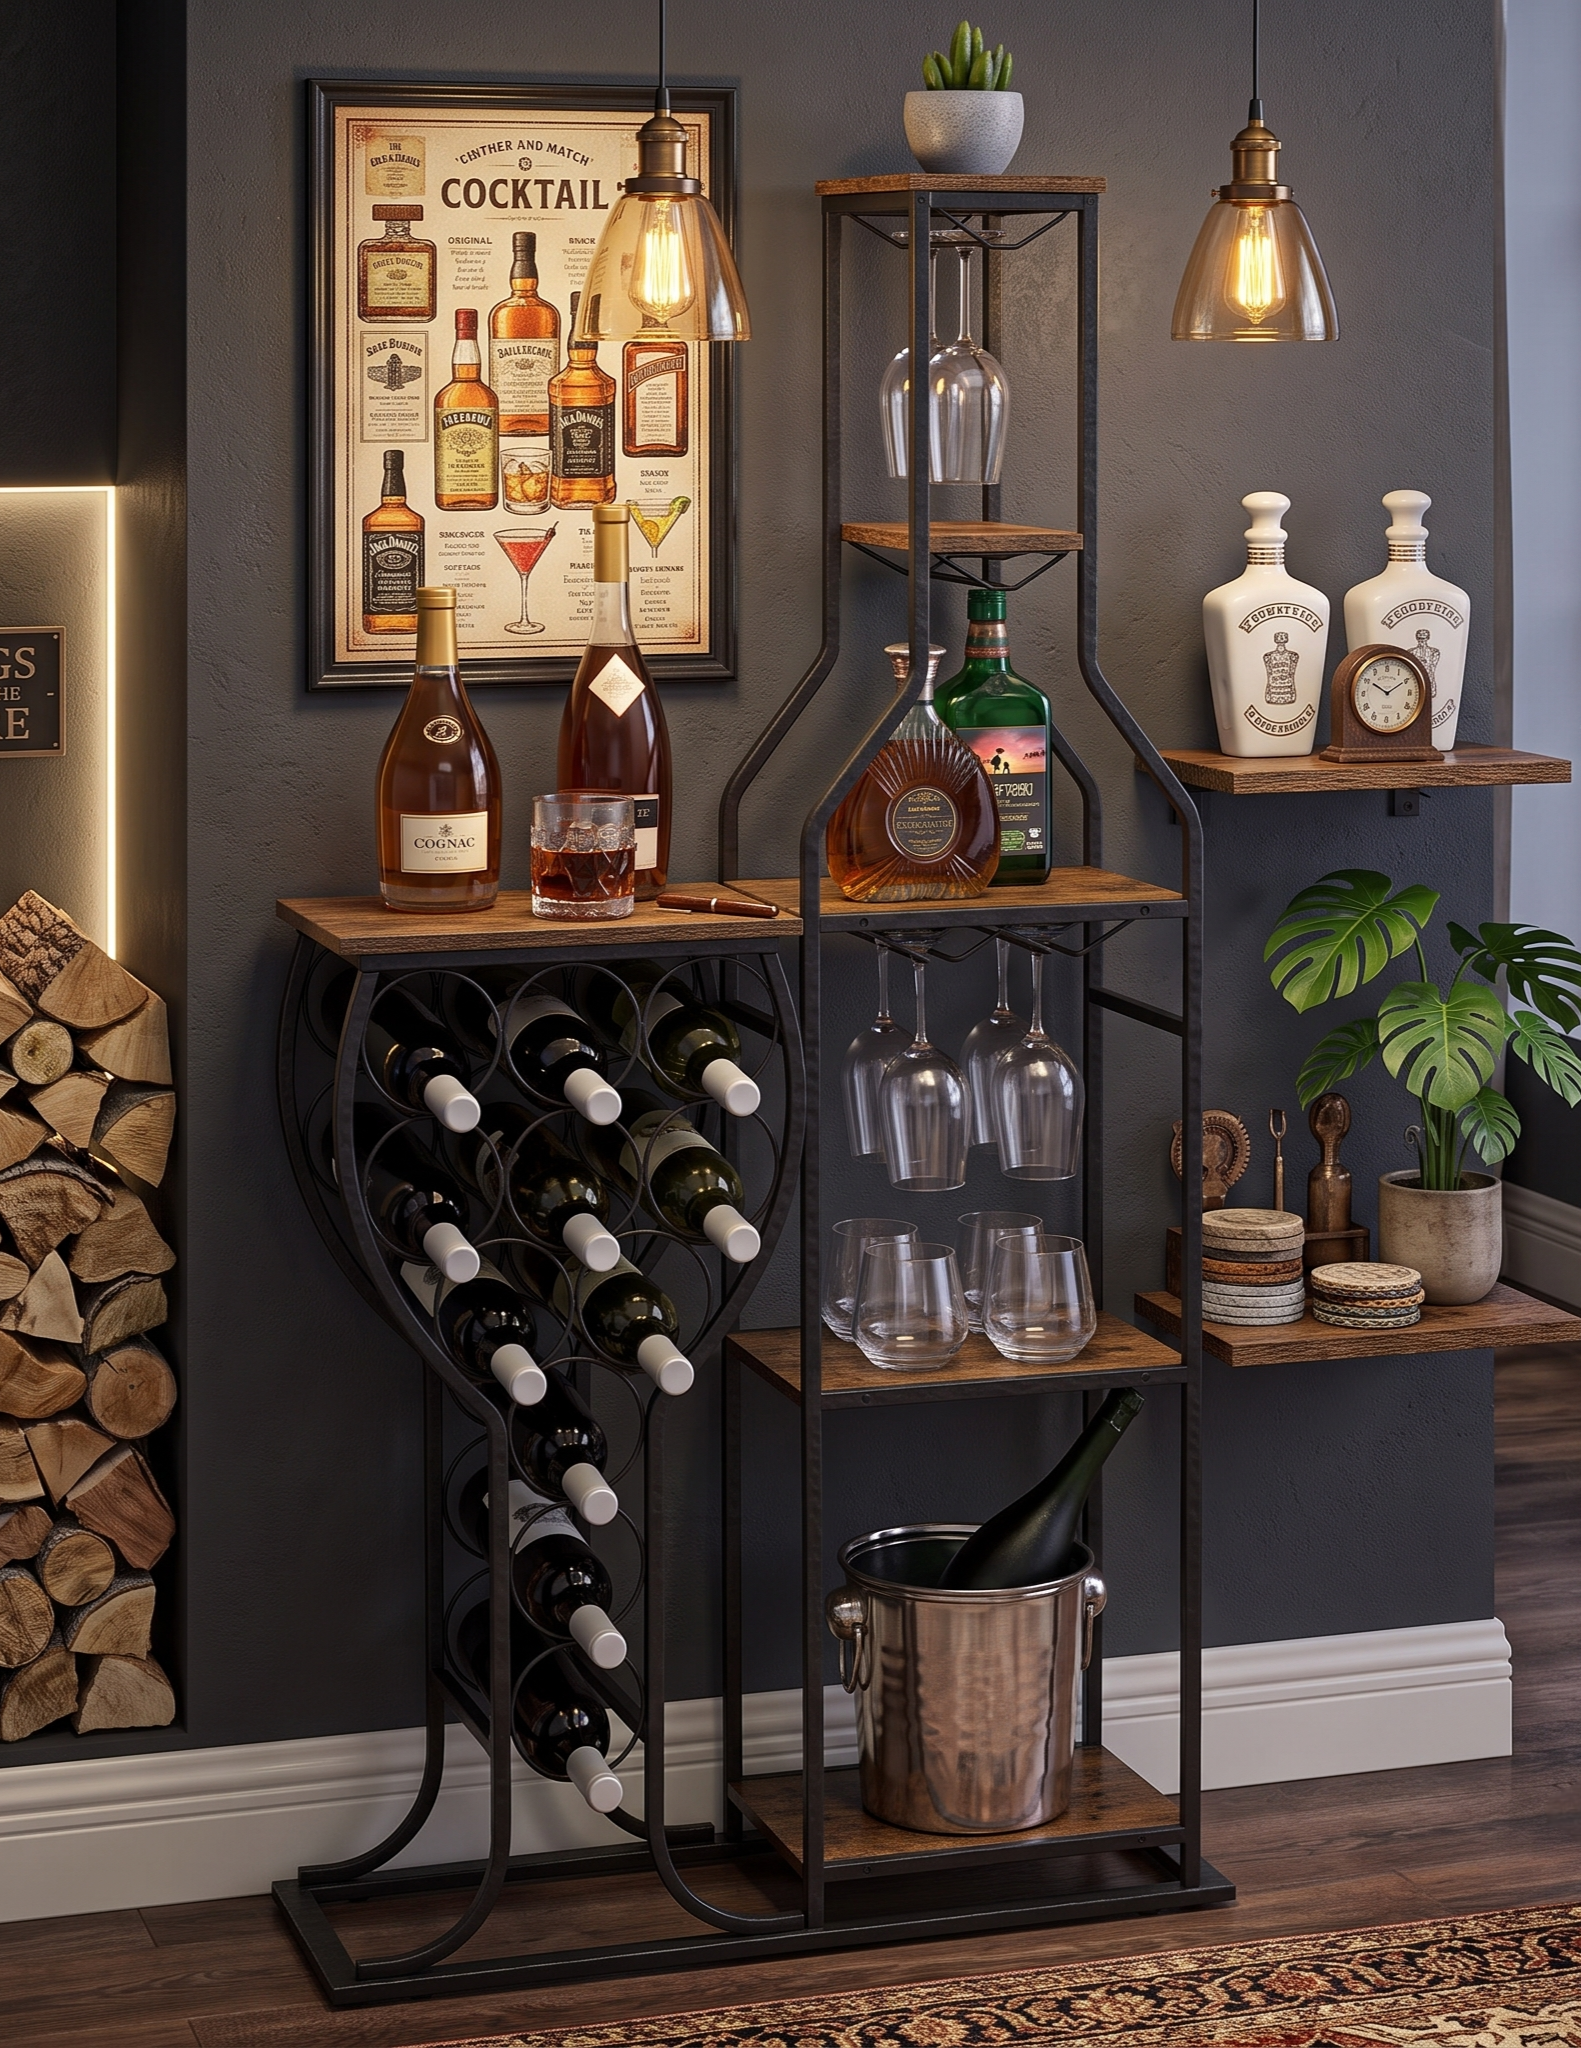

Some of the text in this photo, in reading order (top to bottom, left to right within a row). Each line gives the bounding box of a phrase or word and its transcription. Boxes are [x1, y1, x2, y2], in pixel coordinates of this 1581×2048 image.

[517, 139, 544, 151] AND
[441, 178, 609, 210] COCKTAIL
[0, 707, 29, 740] E
[414, 837, 475, 849] COGNAC
